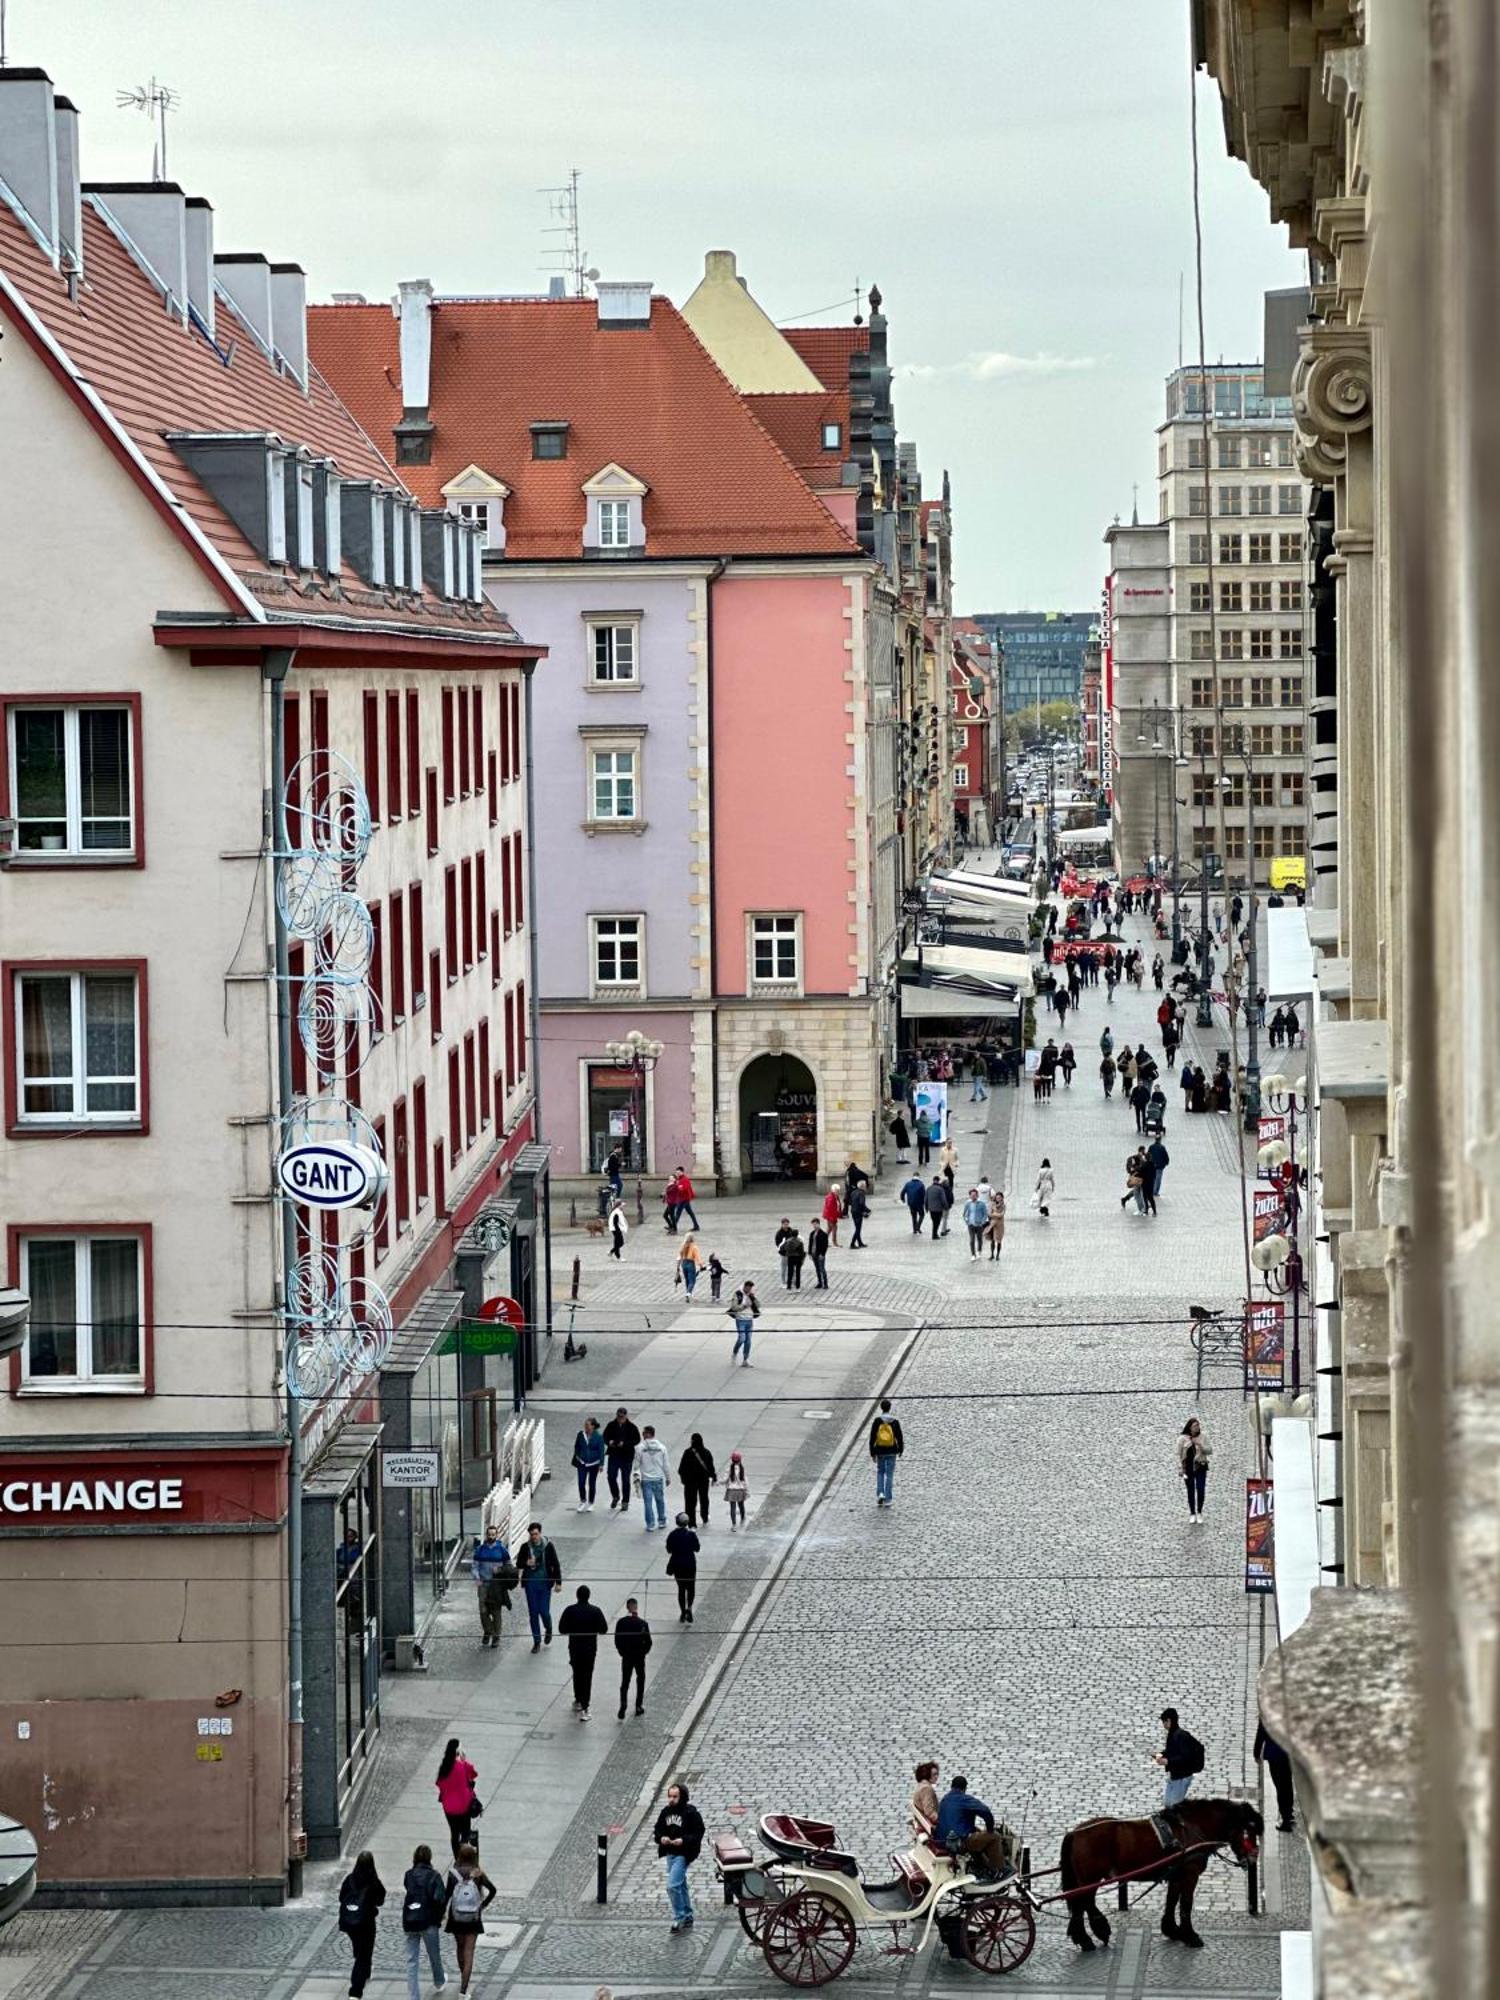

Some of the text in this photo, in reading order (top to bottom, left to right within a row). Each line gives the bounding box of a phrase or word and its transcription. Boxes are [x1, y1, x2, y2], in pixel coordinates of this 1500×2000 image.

[292, 1159, 352, 1192] GANT
[464, 1332, 512, 1345] żabka
[390, 1466, 430, 1474] KANTOR
[0, 1479, 183, 1512] CHANGE
